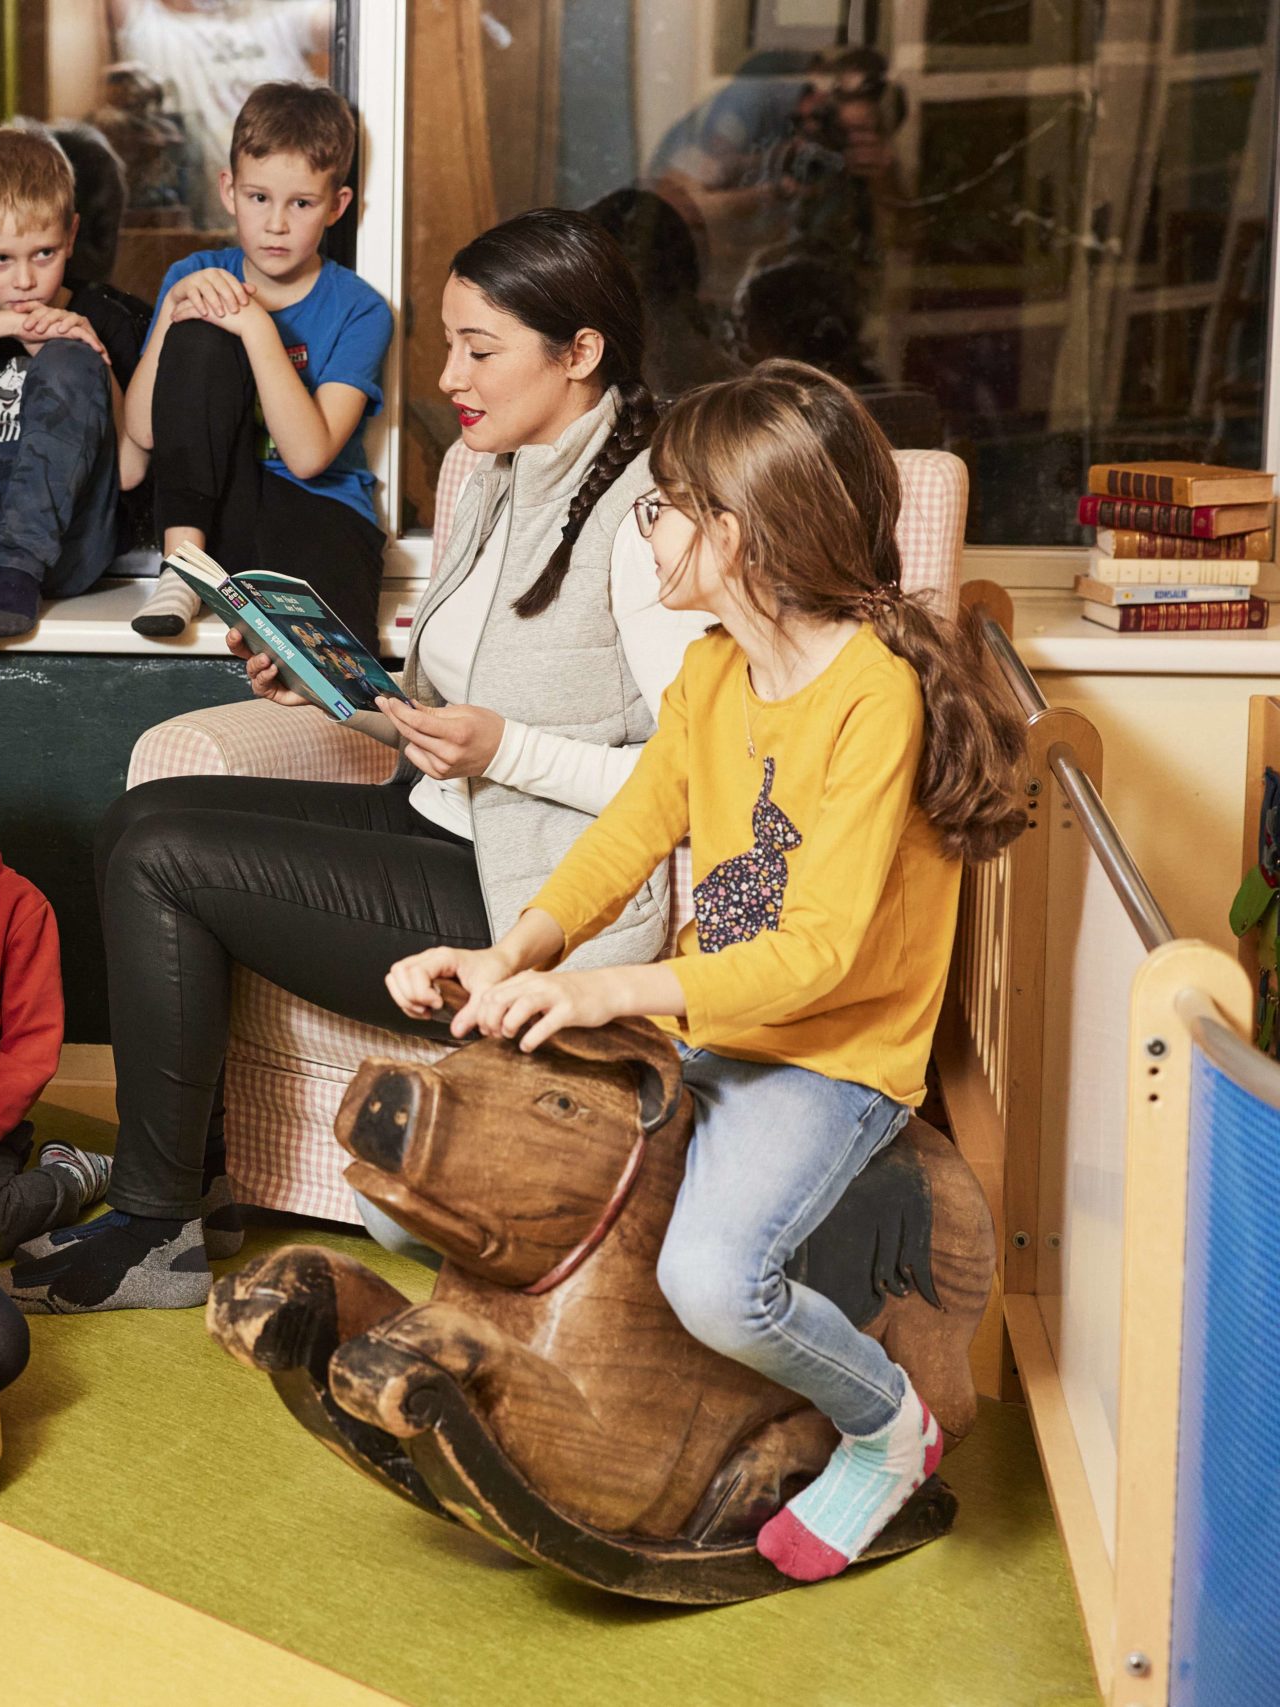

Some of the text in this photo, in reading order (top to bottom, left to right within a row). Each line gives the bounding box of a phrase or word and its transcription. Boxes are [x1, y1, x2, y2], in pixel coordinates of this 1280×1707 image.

[221, 586, 234, 597] Die
[255, 617, 295, 660] Der Fluch der Fee
